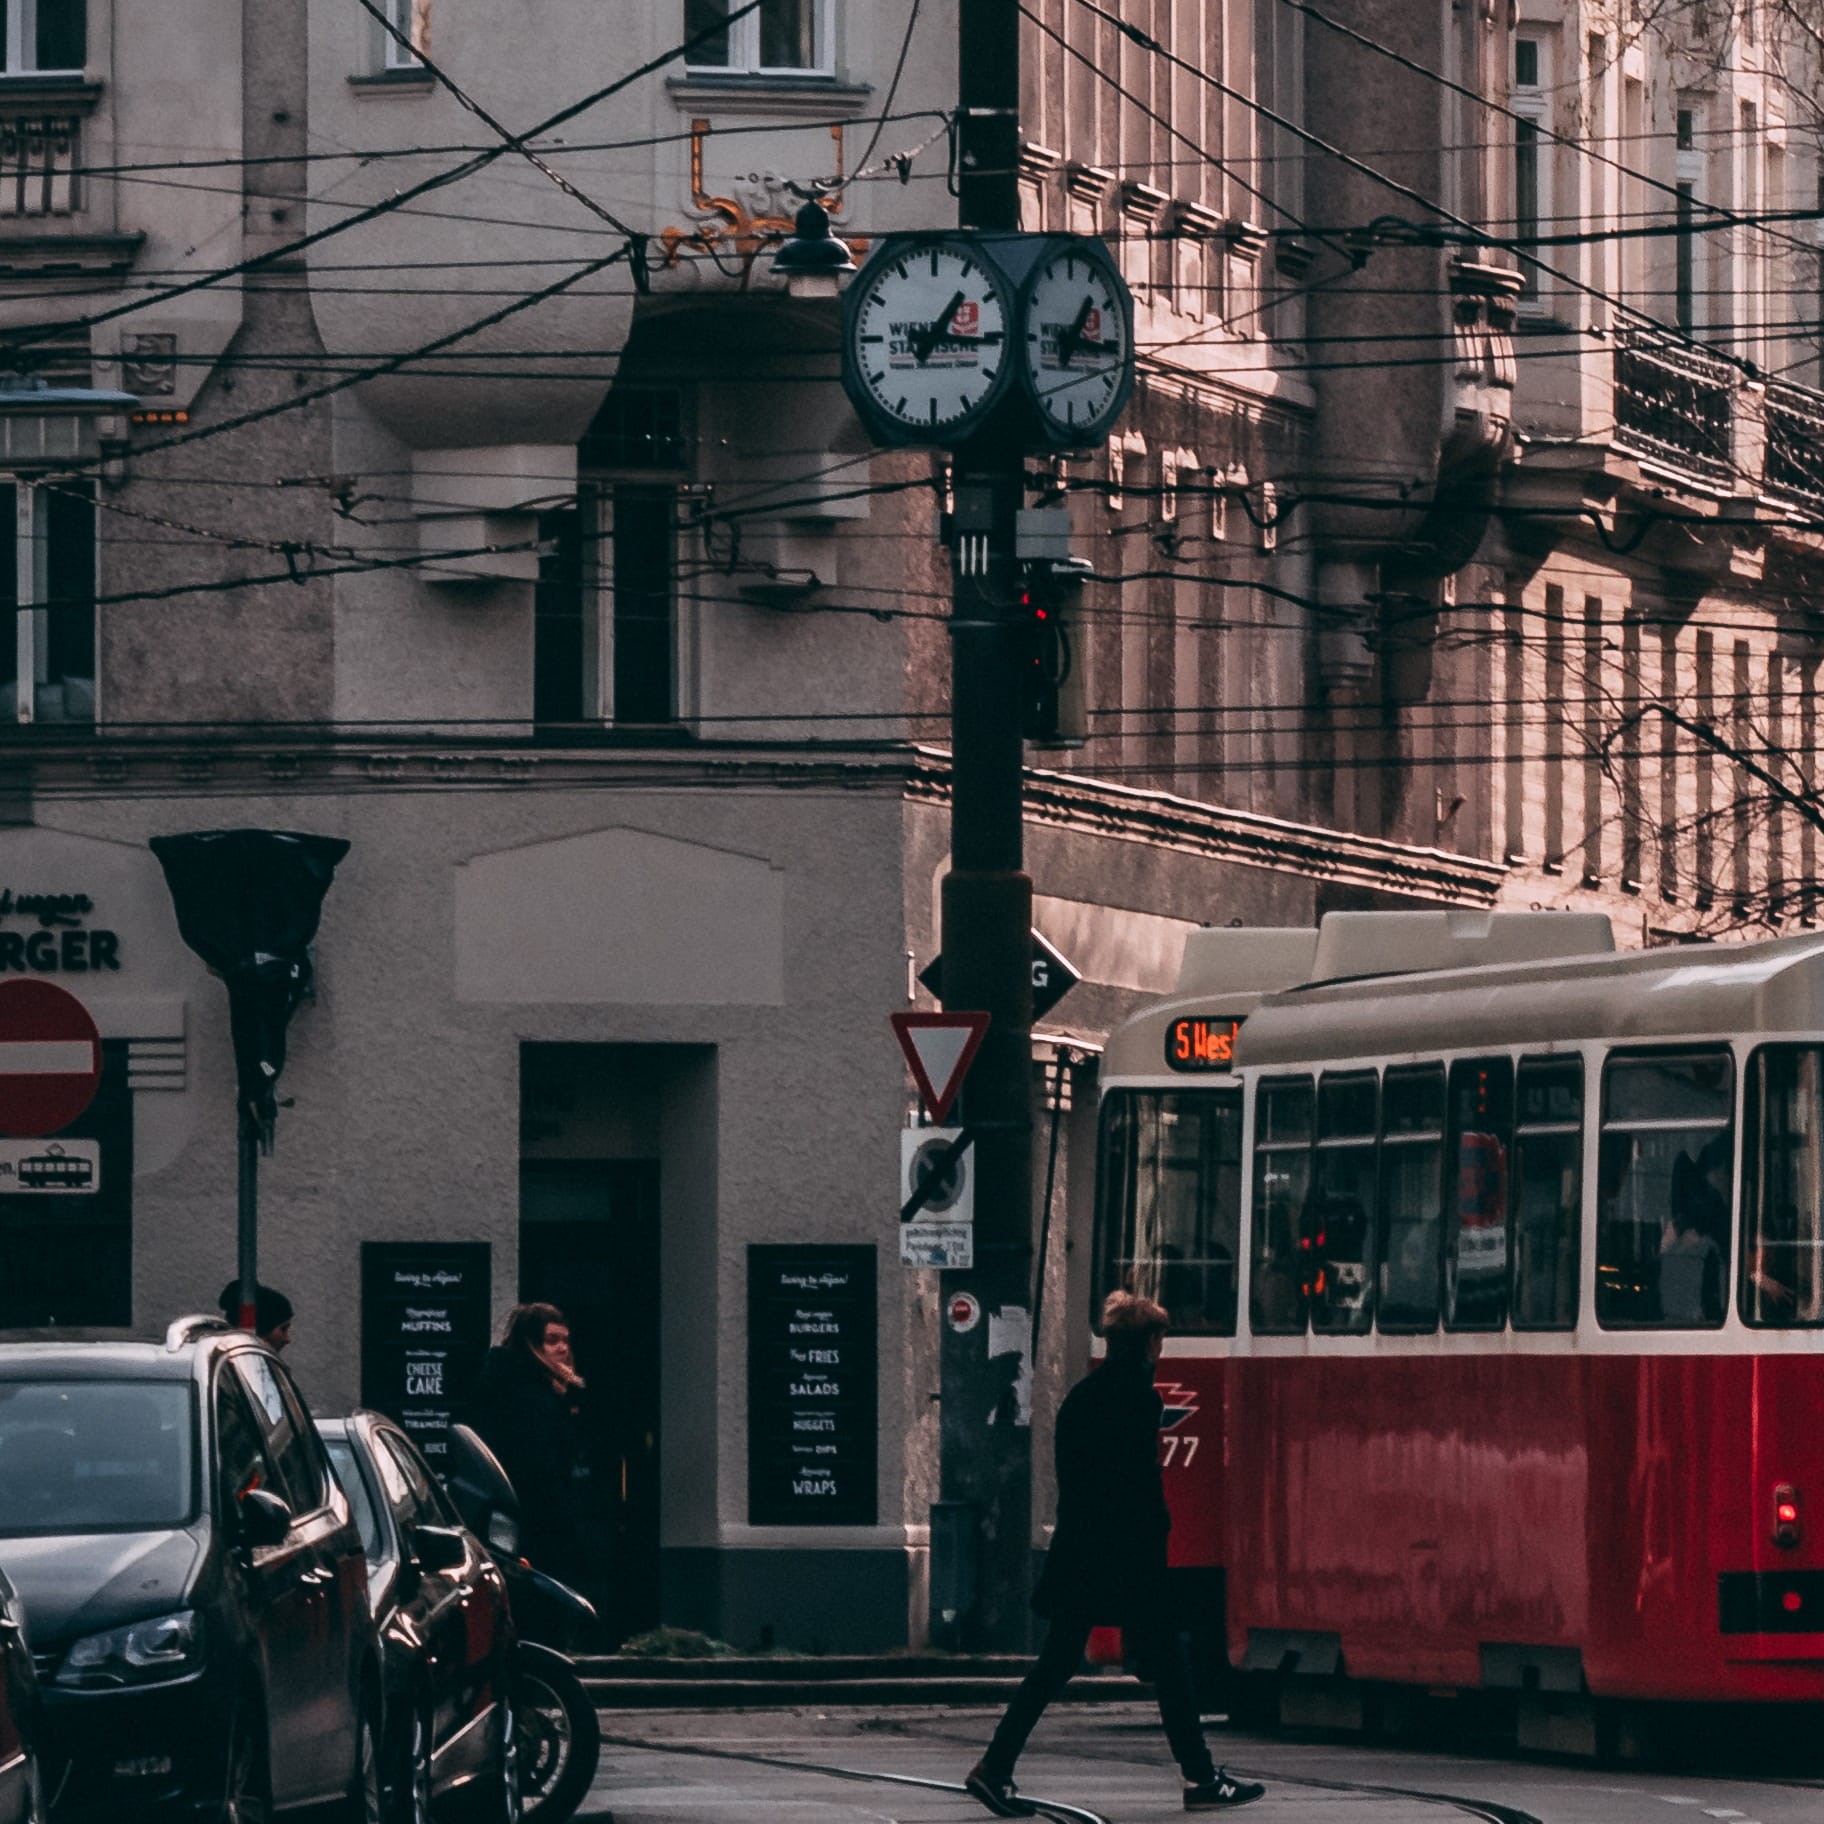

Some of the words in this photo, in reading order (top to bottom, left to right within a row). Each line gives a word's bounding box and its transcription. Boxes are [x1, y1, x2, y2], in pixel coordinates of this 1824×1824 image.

[406, 1376, 444, 1395] CAKE
[789, 1383, 840, 1396] SALADS
[792, 1480, 838, 1496] WRAPS
